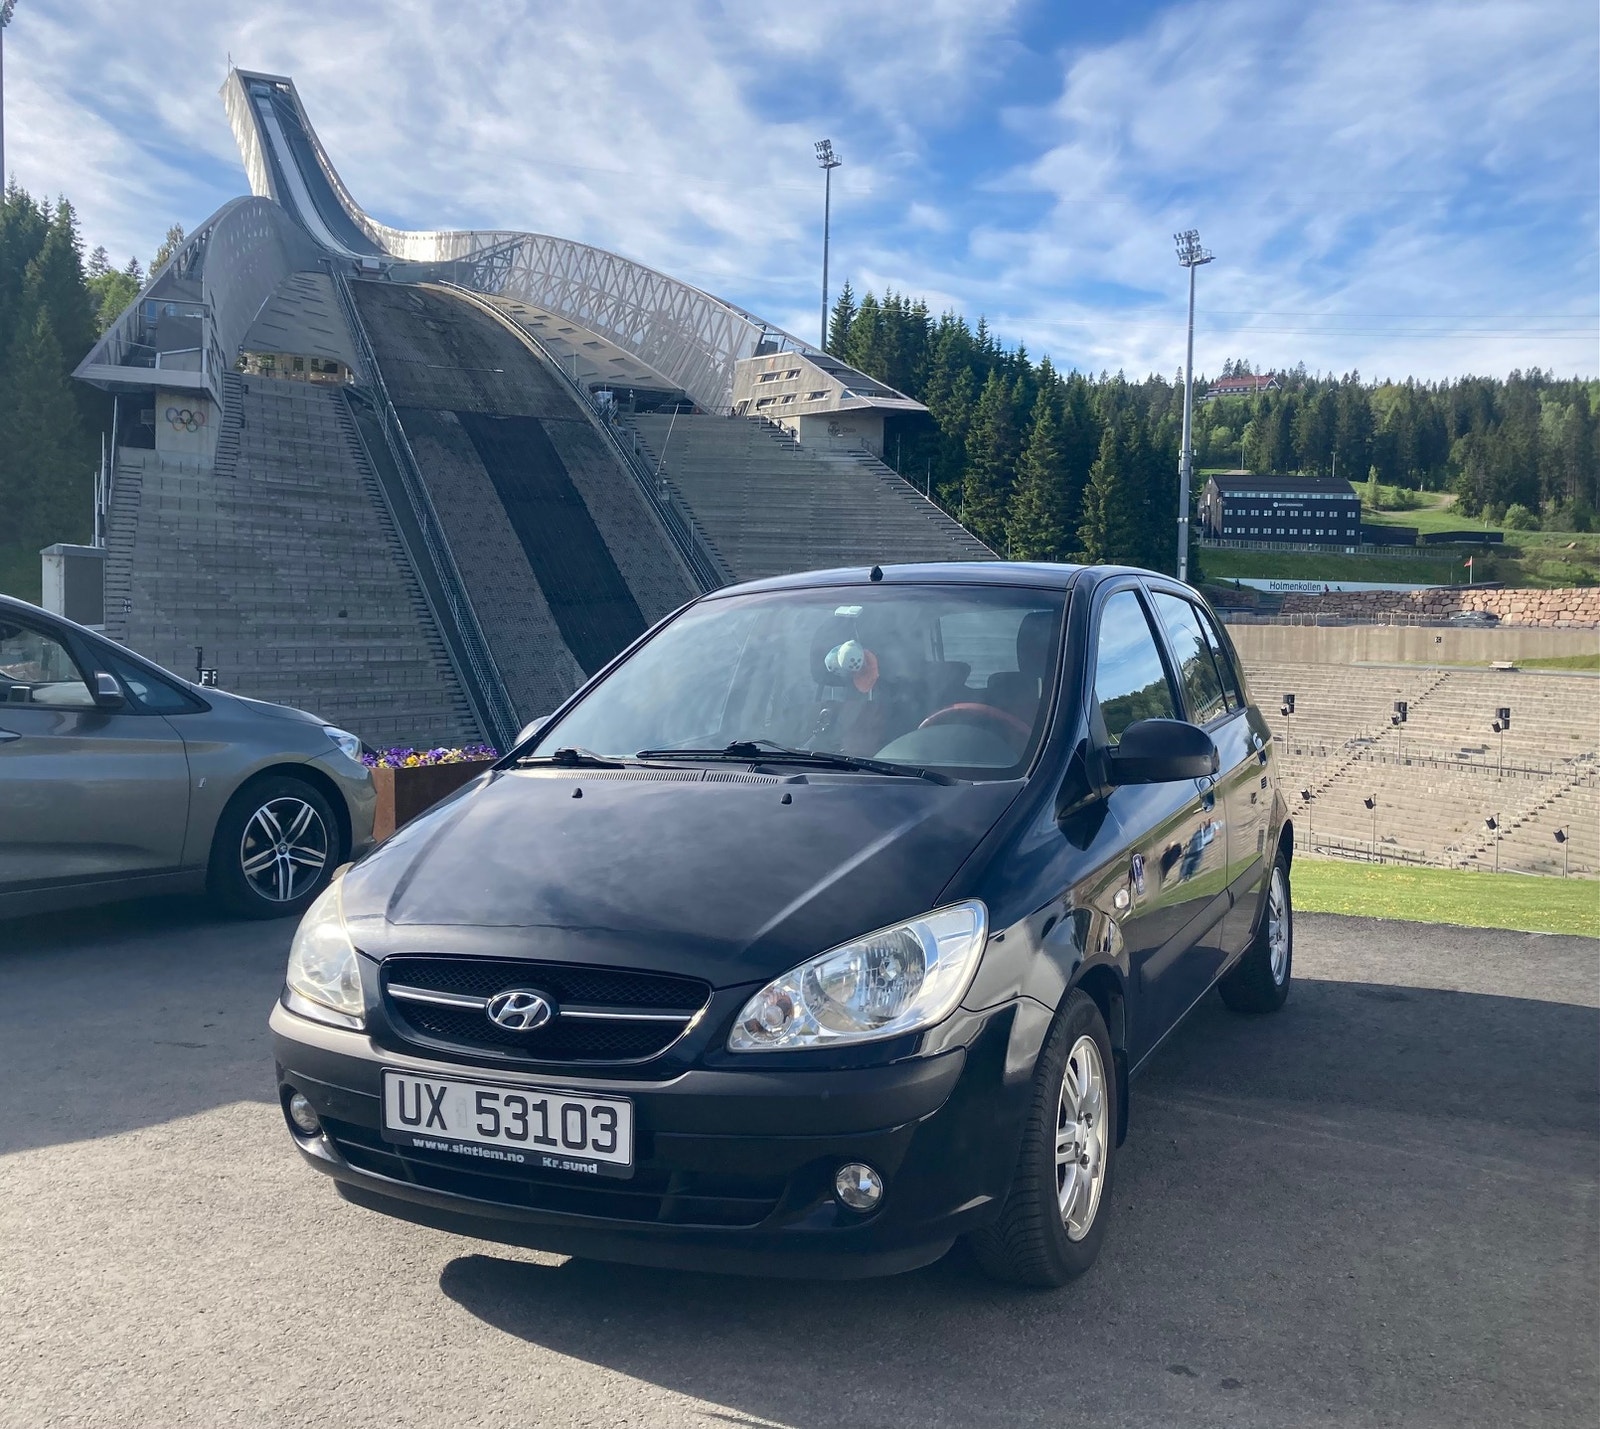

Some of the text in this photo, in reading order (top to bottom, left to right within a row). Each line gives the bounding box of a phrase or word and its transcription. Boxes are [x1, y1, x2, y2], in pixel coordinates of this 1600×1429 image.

[1269, 581, 1321, 591] Holmenkollen
[398, 1079, 618, 1154] UX 53103
[542, 1156, 597, 1174] Kr.sund
